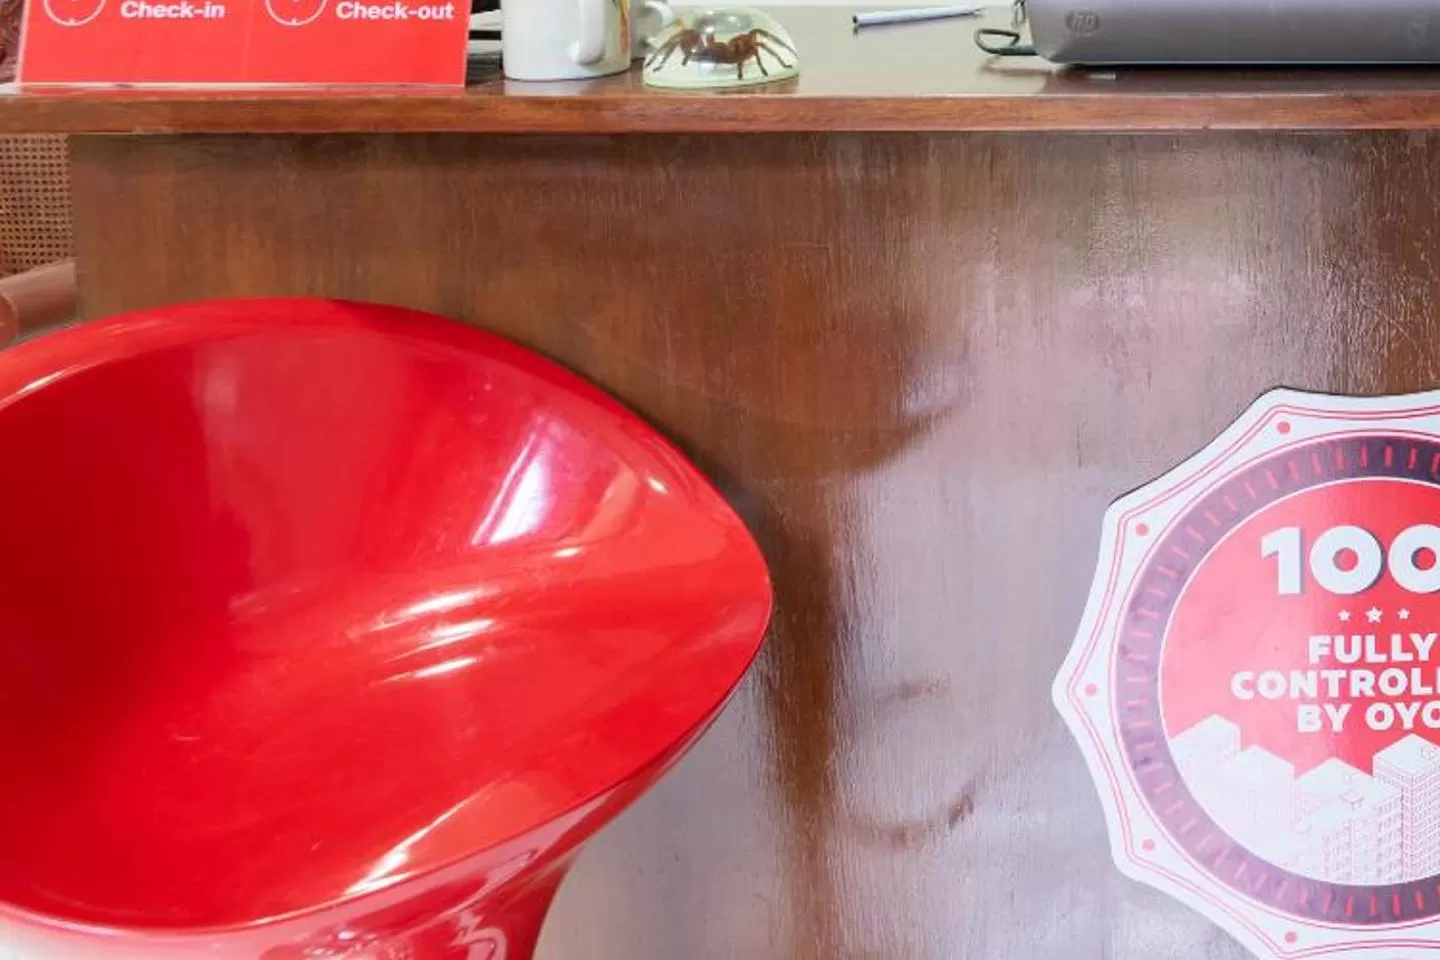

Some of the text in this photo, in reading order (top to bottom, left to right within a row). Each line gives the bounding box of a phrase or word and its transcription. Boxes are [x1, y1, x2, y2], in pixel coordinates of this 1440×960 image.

[120, 0, 226, 20] Check-in
[335, 1, 455, 21] Check-out
[1307, 632, 1439, 665] FULLY
[1296, 703, 1352, 733] BY
